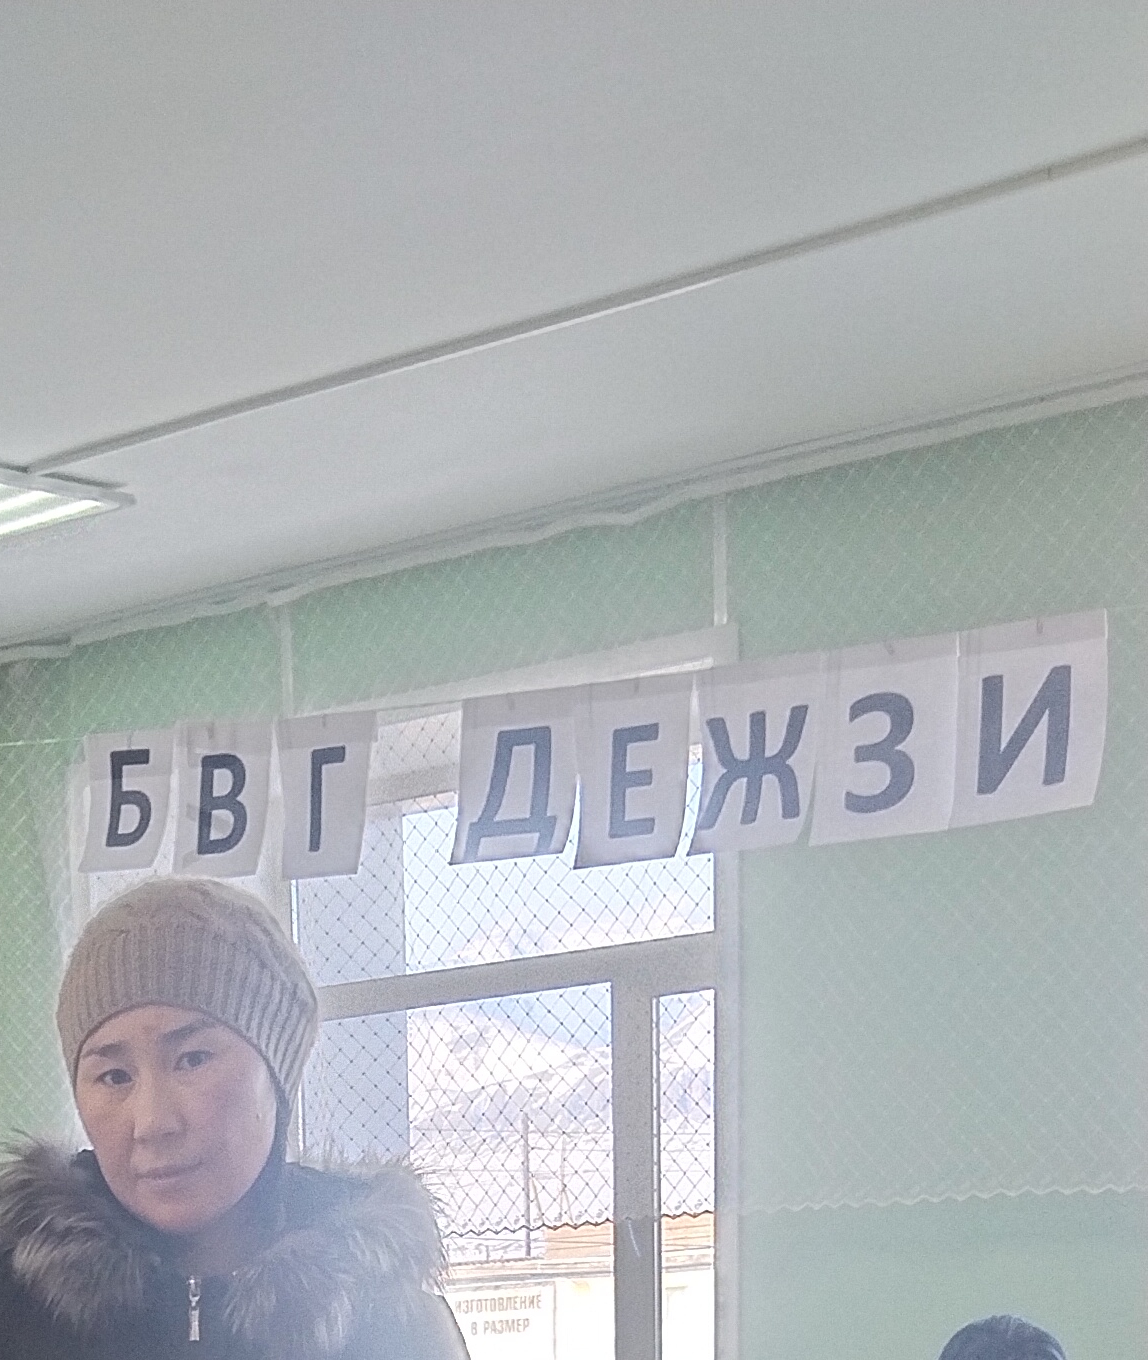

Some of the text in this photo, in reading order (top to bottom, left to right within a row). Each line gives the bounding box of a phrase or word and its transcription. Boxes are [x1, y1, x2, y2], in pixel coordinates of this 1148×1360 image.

[104, 748, 152, 848] Б
[196, 753, 248, 854] В
[307, 745, 347, 852] Г
[465, 726, 558, 862] Д
[609, 722, 660, 838] Е
[704, 703, 809, 829] Ж
[844, 692, 916, 813] З
[975, 665, 1073, 796] И
[455, 1294, 542, 1315] ИЗГОТОВЛЕНИЕ
[483, 1318, 530, 1335] РАЗМЕР
